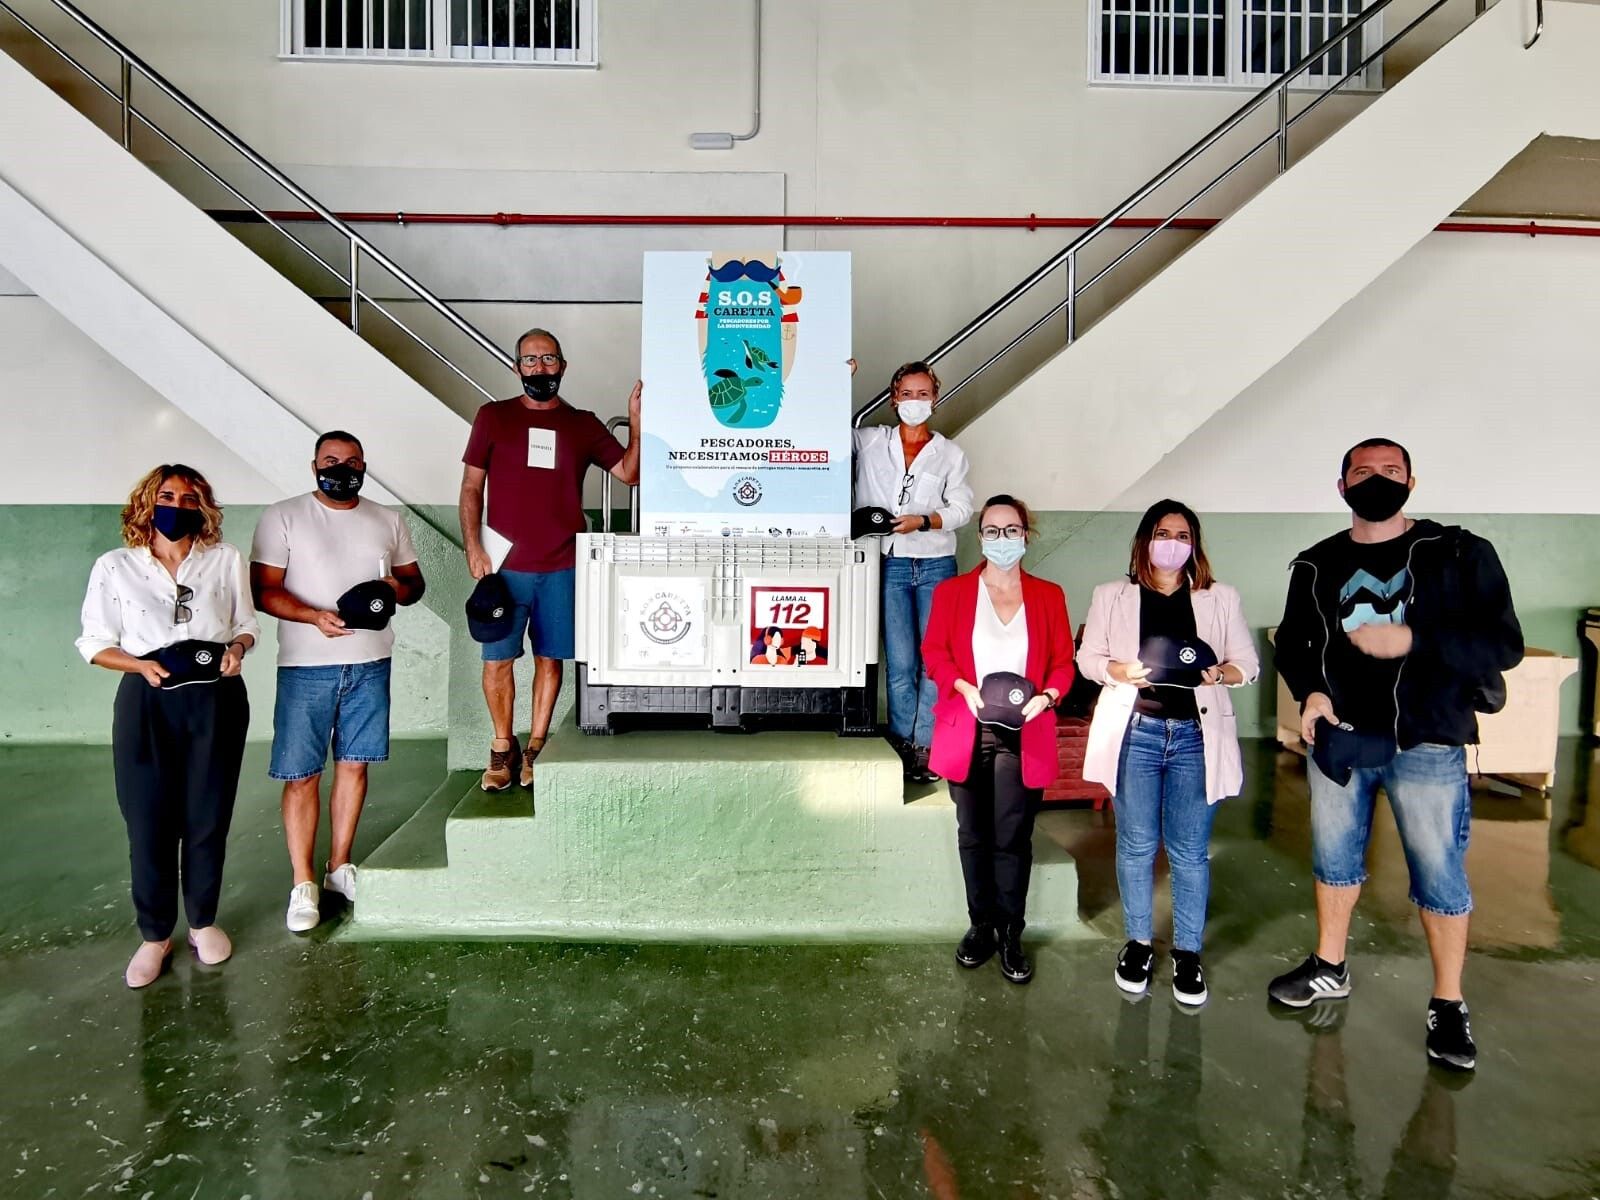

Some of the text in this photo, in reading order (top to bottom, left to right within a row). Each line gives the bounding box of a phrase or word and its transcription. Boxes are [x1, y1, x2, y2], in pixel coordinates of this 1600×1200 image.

[718, 291, 772, 306] S.O.S
[714, 308, 775, 316] CARETTA
[700, 438, 795, 449] PESCADORES,
[668, 451, 769, 461] NECESITAMOS
[768, 603, 812, 625] 112
